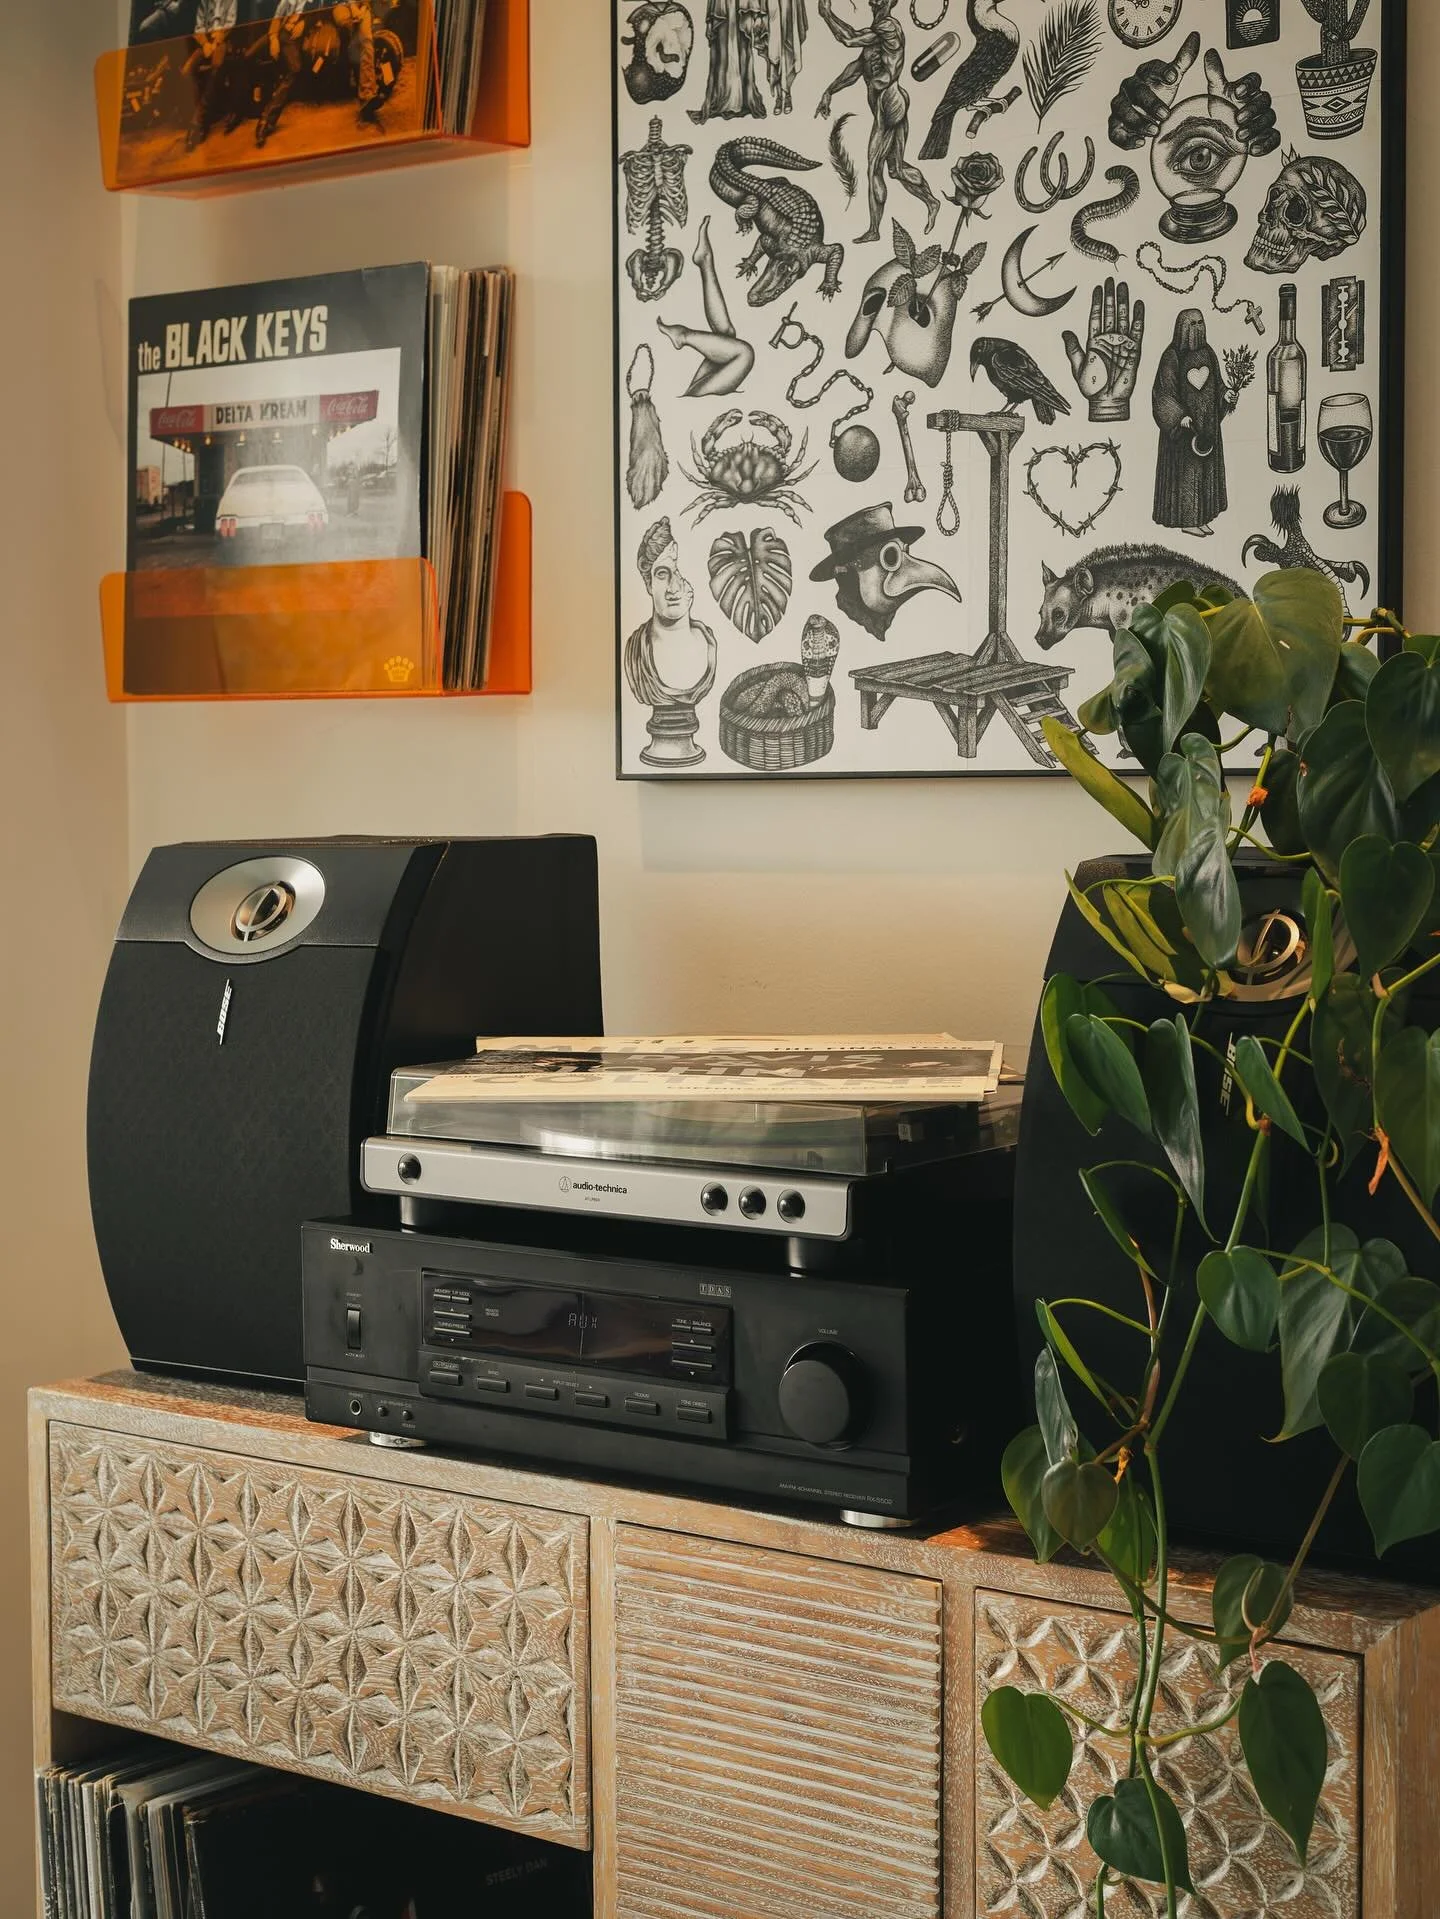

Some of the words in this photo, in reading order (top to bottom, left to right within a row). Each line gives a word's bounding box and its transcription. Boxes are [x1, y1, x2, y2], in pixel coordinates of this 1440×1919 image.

[138, 341, 161, 372] the
[165, 315, 248, 368] BLACK
[255, 305, 328, 359] KEYS
[216, 404, 254, 425] DELTA
[260, 400, 308, 421] KREAM
[217, 979, 232, 1046] BOSE
[625, 1054, 885, 1063] DAVIS
[474, 1074, 963, 1087] COLTRANE
[572, 1181, 628, 1195] audio-technica
[330, 1238, 370, 1253] Sherwood
[568, 1312, 598, 1329] AUX
[485, 1864, 524, 1887] STEELY
[525, 1857, 548, 1874] DAN
